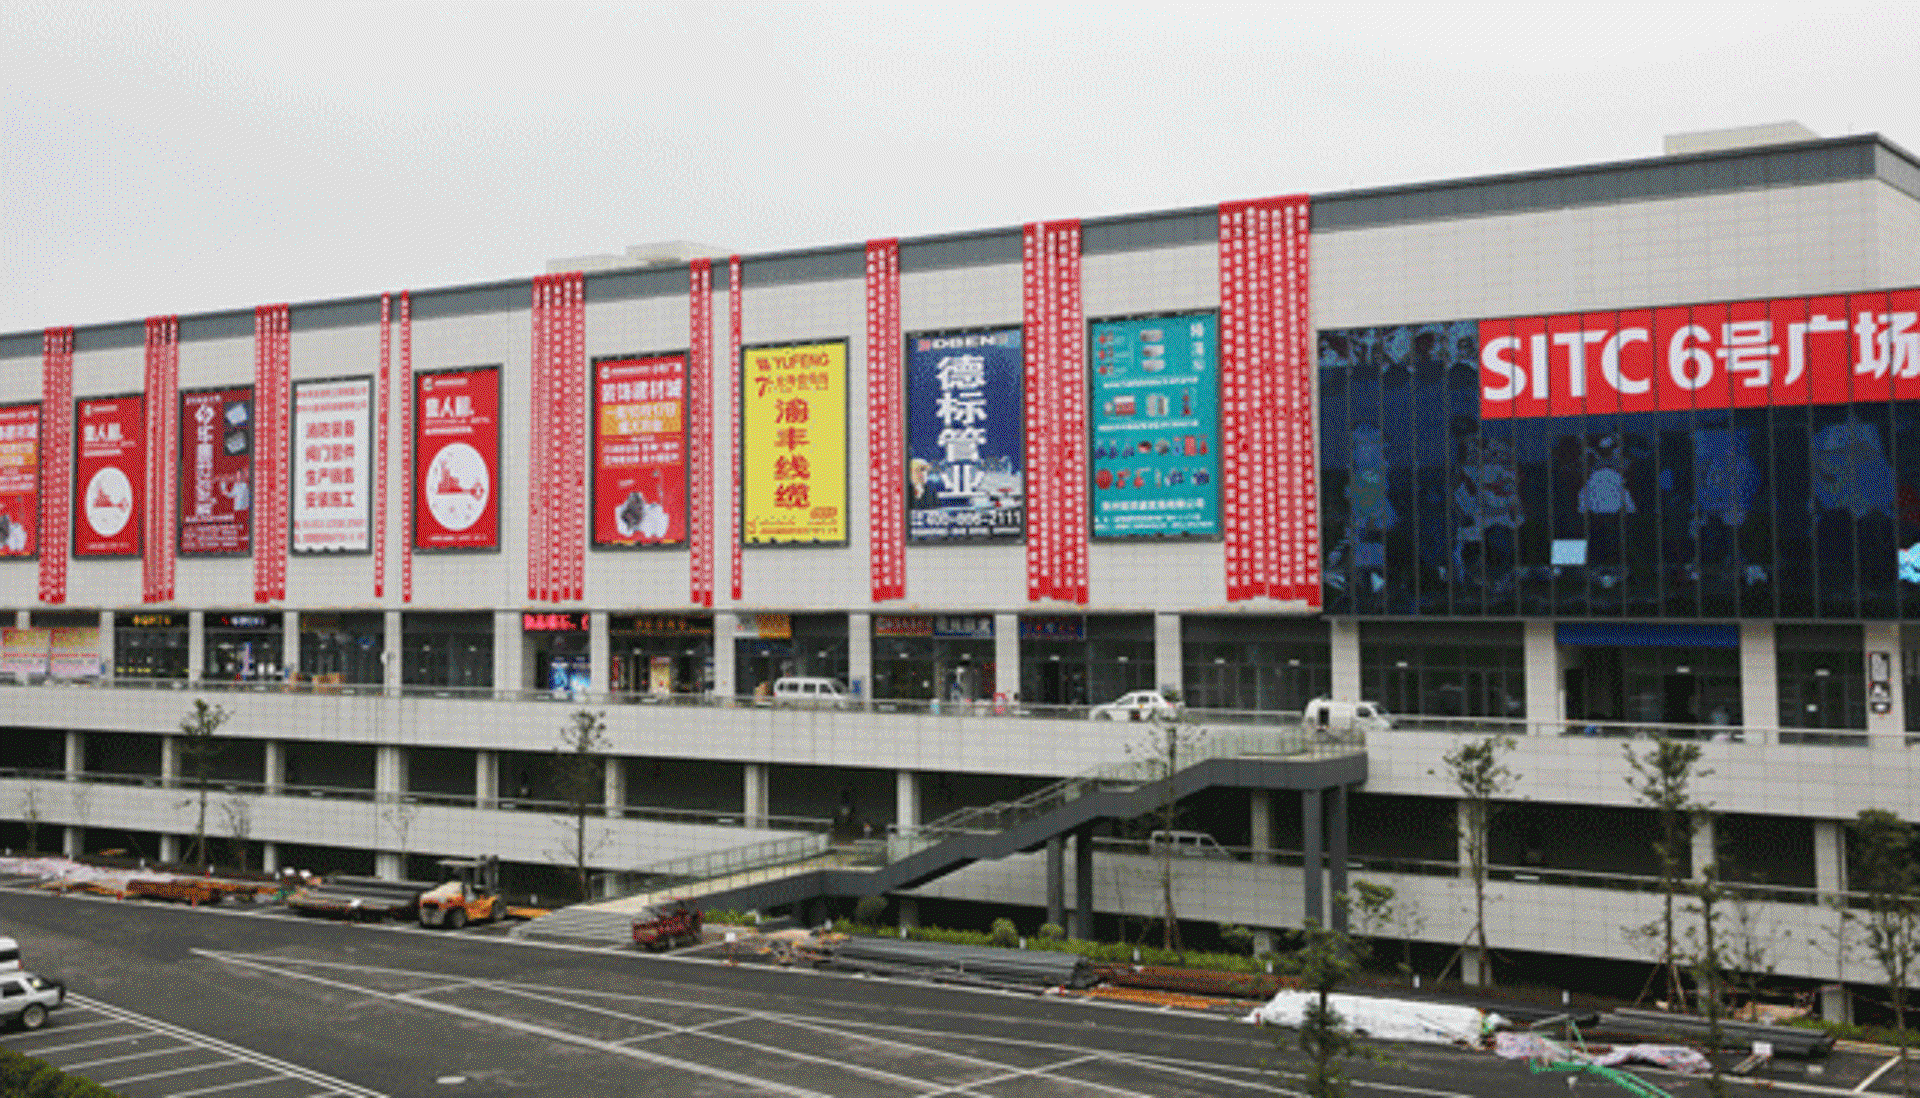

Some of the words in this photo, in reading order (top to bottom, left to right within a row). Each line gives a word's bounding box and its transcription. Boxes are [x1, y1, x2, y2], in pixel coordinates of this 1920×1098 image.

[772, 353, 831, 370] YUFENG
[1481, 326, 1651, 401] SITC
[1667, 311, 1920, 391] 6号广场
[774, 396, 810, 510] 渝丰线缆
[936, 354, 988, 498] 德标管业
